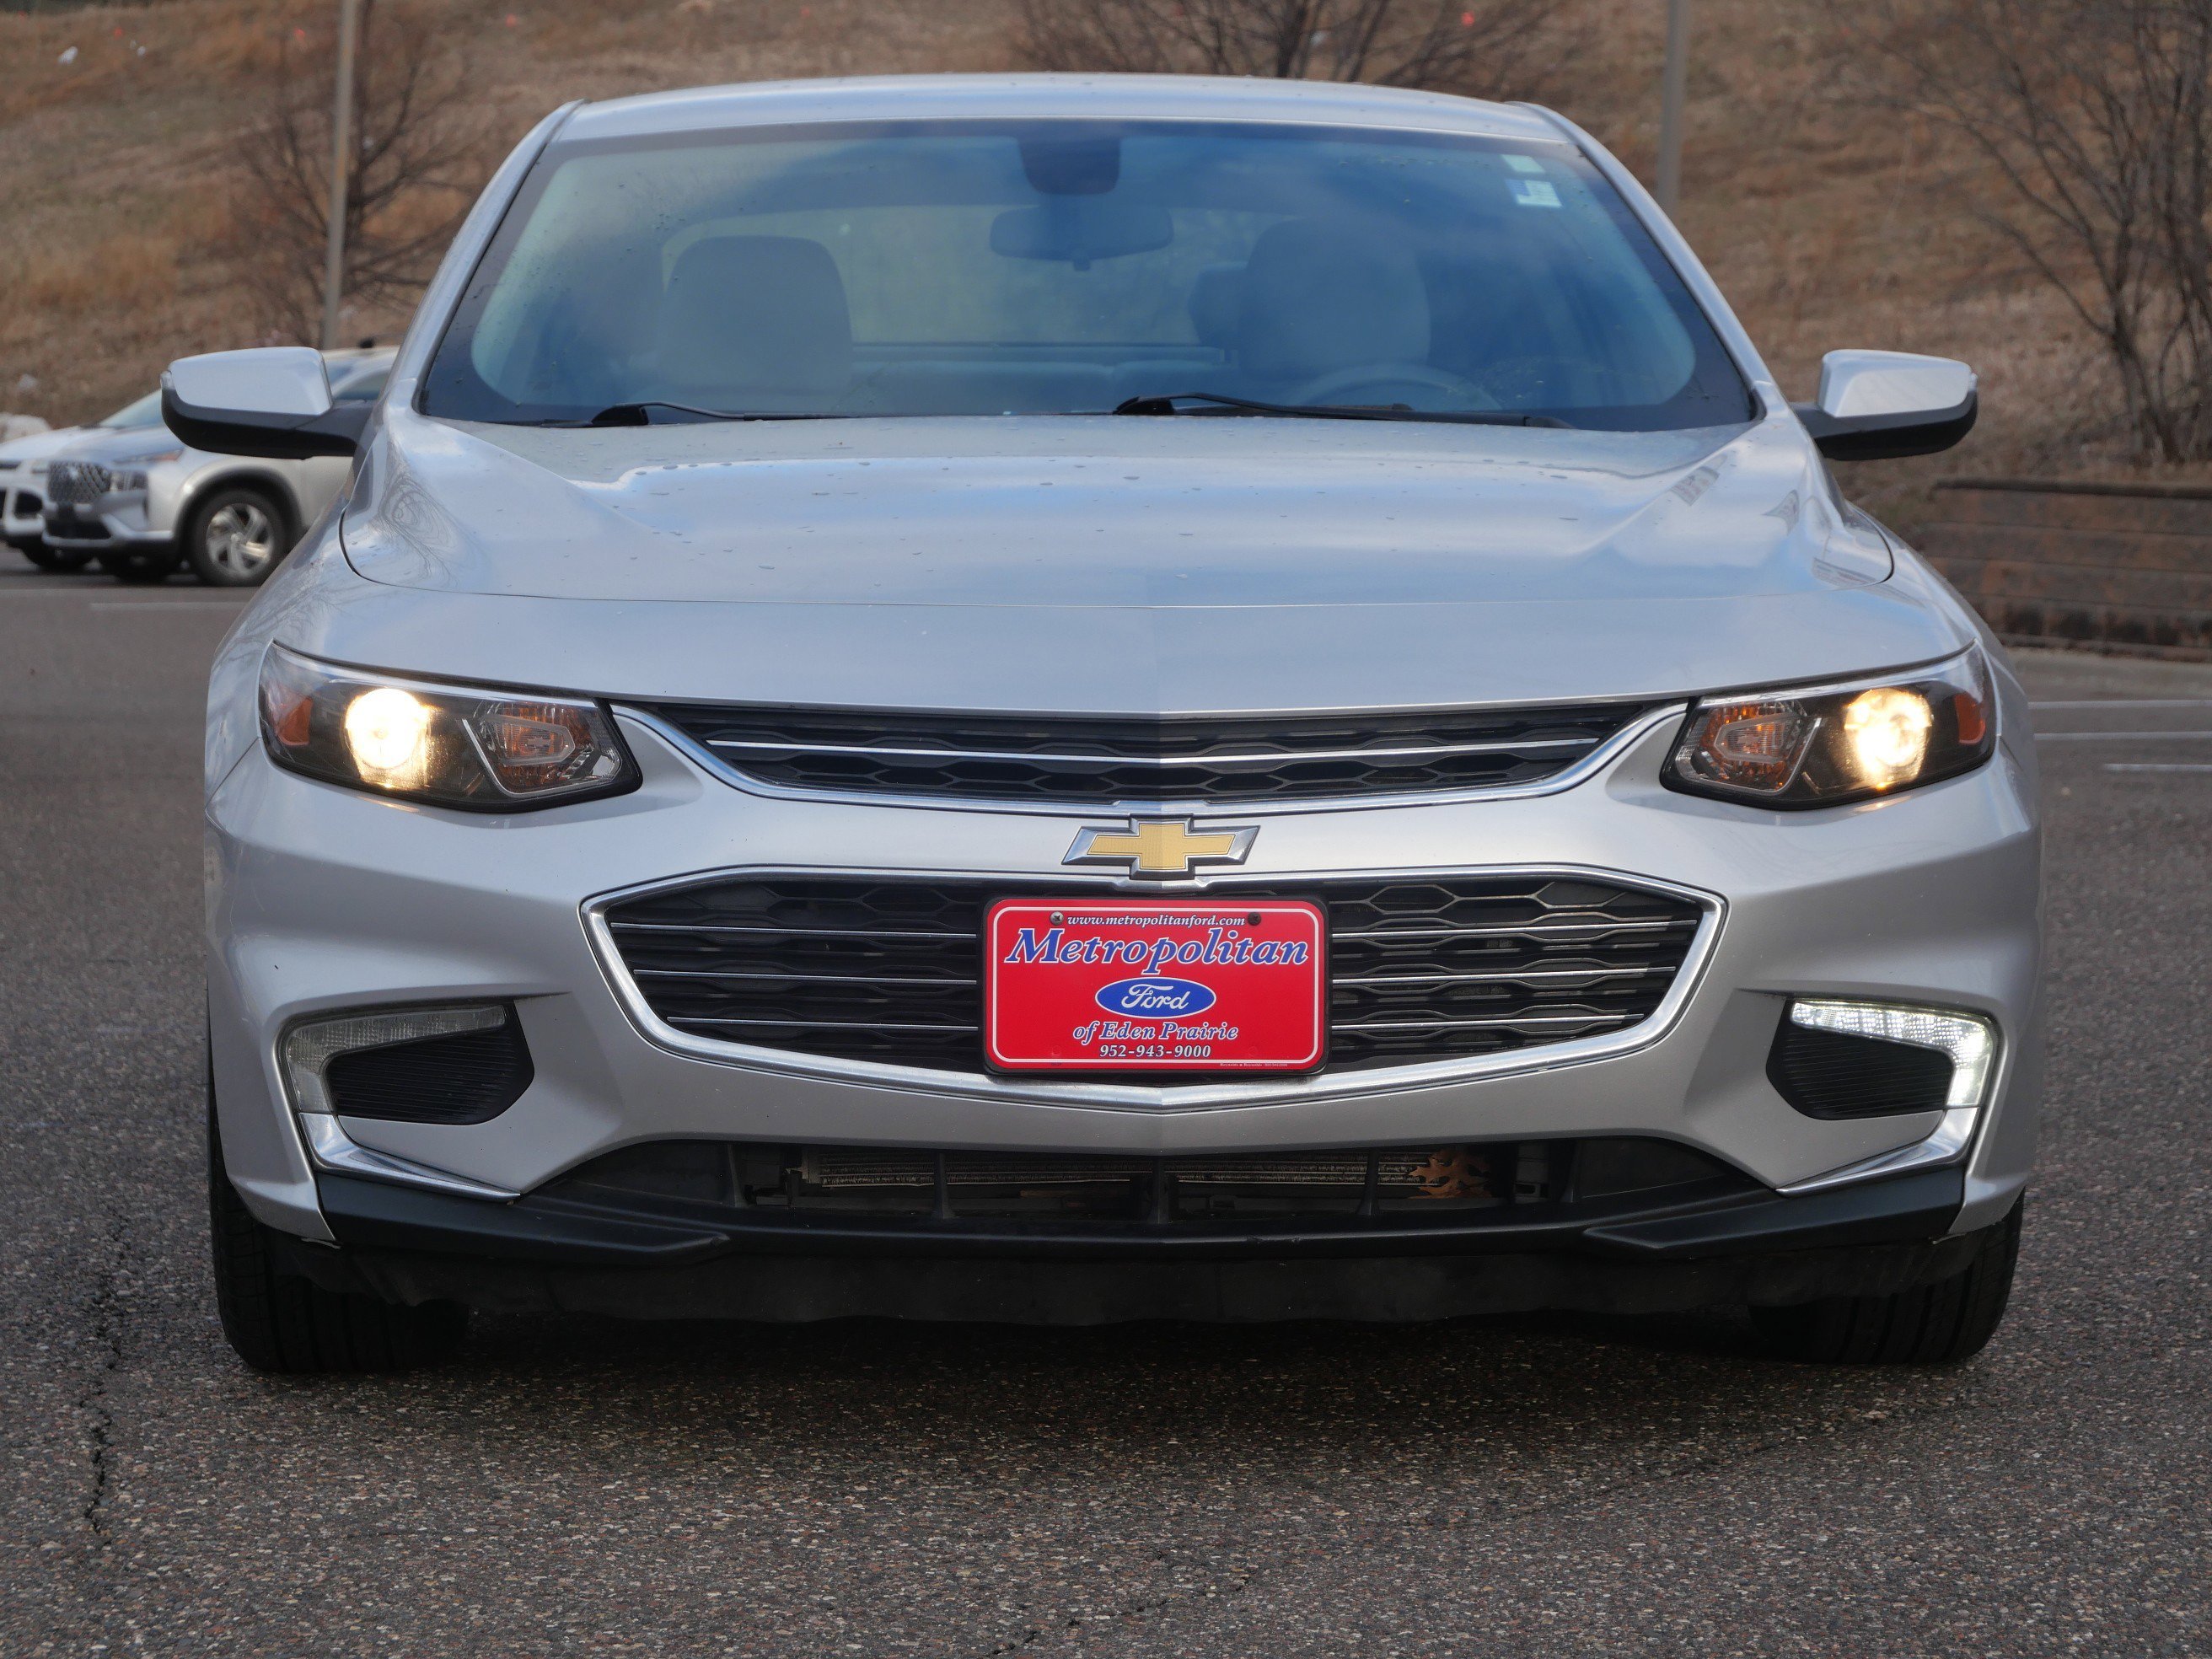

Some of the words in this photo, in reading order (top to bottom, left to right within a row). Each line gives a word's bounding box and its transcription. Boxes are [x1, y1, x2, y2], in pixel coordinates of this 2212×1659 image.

[1067, 915, 1245, 928] www.metropolitanford.com
[1004, 927, 1308, 974] Metropolitan
[1121, 984, 1191, 1010] Ford
[1073, 1021, 1099, 1045] of
[1098, 1022, 1155, 1040] Eden
[1158, 1022, 1238, 1040] Prairie
[1099, 1044, 1211, 1058] 952-943-9000
